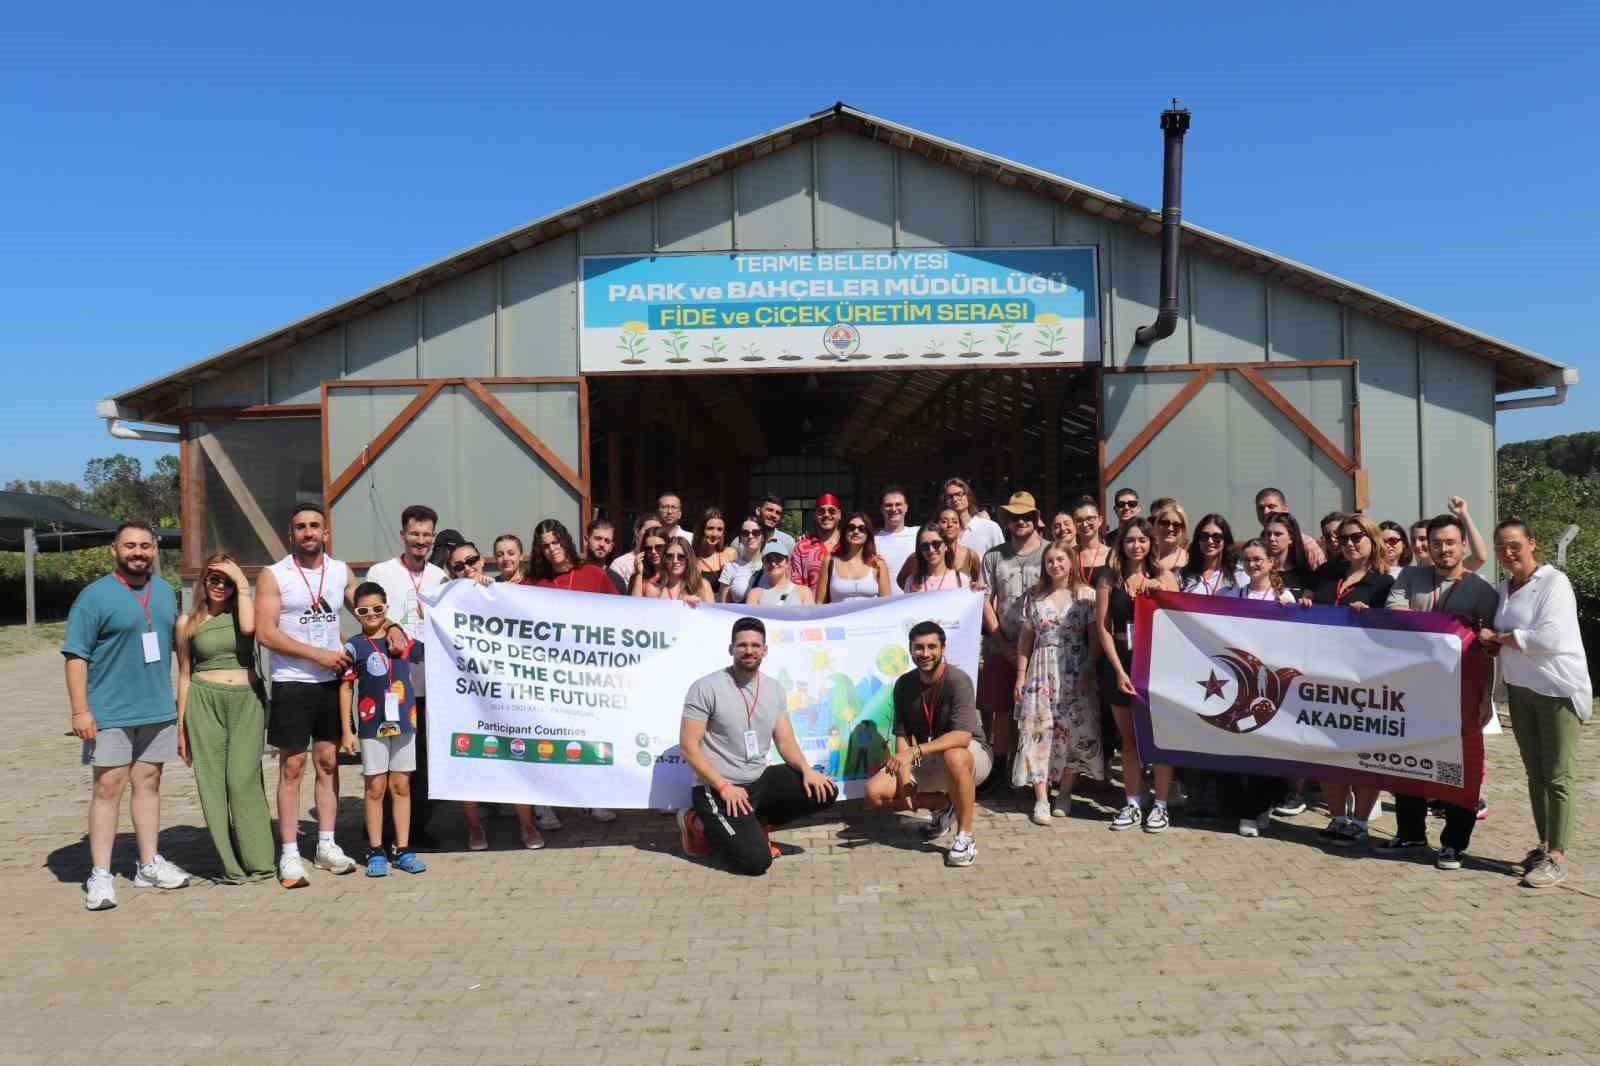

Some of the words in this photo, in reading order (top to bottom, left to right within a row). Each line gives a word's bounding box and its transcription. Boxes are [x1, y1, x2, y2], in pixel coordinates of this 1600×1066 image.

[735, 255, 813, 273] TERME
[608, 282, 687, 303] PARK
[690, 285, 723, 300] ve
[727, 278, 880, 301] BAHÇELER
[884, 272, 1068, 297] MÜDÜRLÜĞÜ
[660, 304, 717, 327] FİDE
[721, 311, 750, 325] ve
[836, 300, 932, 322] ÜRETİM
[937, 302, 1029, 321] SERASI
[454, 612, 566, 642] PROTECT
[571, 624, 616, 646] THE
[453, 634, 502, 654] STOP
[507, 644, 641, 668] DEGRADATION
[456, 656, 505, 676] SAVE
[510, 662, 549, 682] THE
[455, 677, 503, 699] SAVE
[506, 682, 545, 701] THE
[1298, 681, 1406, 712] GENÇLİK
[477, 719, 532, 736] Participant
[1296, 709, 1405, 738] AKADEMİSİ
